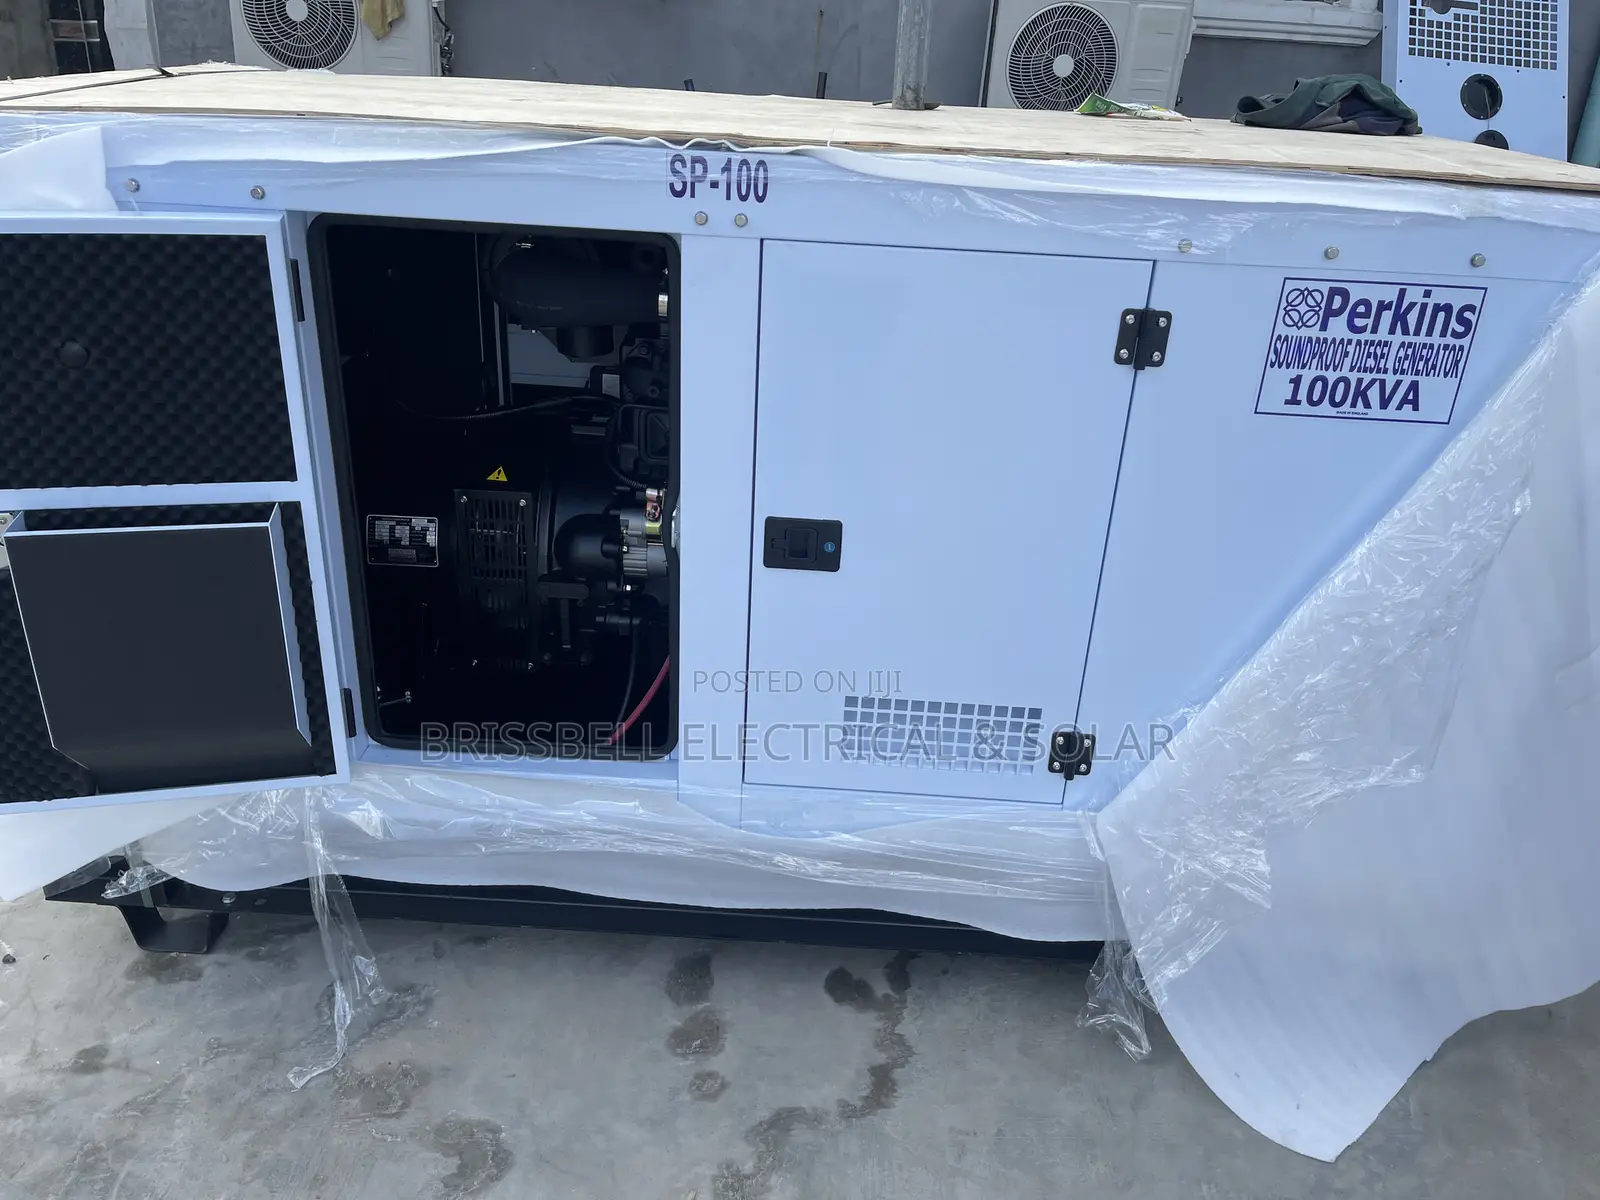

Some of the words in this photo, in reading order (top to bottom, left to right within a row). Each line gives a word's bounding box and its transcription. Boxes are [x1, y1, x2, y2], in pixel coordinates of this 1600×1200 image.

[669, 153, 768, 203] SP-100
[1319, 286, 1477, 339] Perkins
[1269, 334, 1353, 372] SOUNDPROOF
[1348, 337, 1393, 374] DIESEL
[1392, 341, 1465, 378] GENERATOR
[1284, 374, 1420, 412] 100KVA
